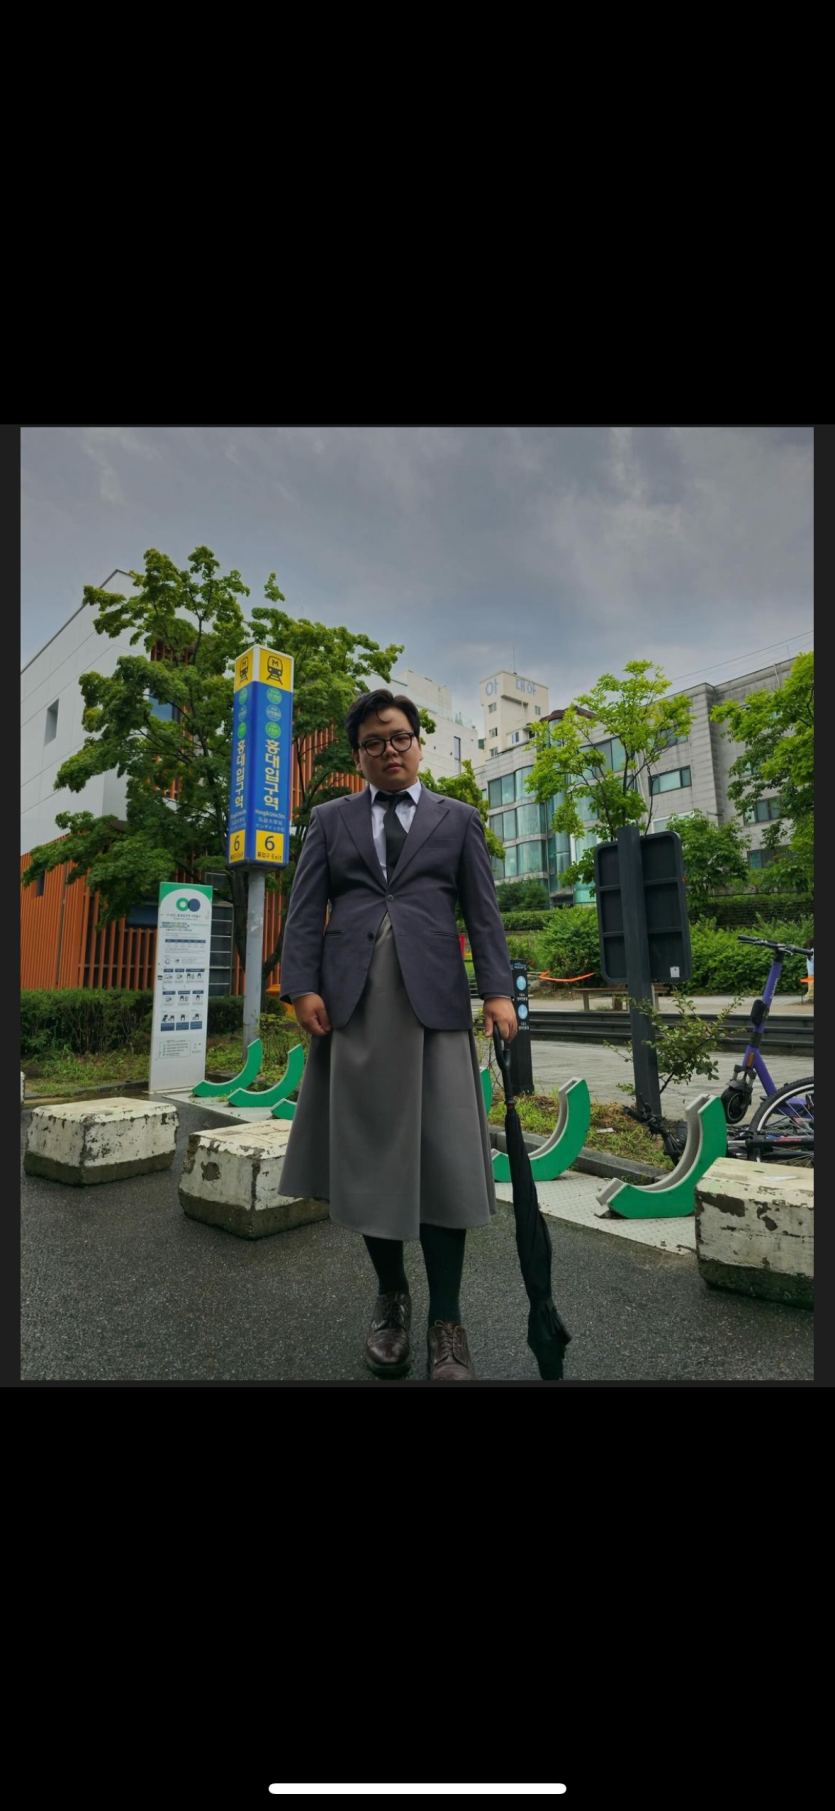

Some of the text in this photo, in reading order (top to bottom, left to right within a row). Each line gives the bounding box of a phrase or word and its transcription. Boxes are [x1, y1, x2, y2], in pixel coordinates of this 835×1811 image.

[235, 739, 246, 808] 홍대입구역
[264, 739, 280, 811] 홍대입구역
[234, 835, 240, 851] 6
[264, 836, 275, 851] 6
